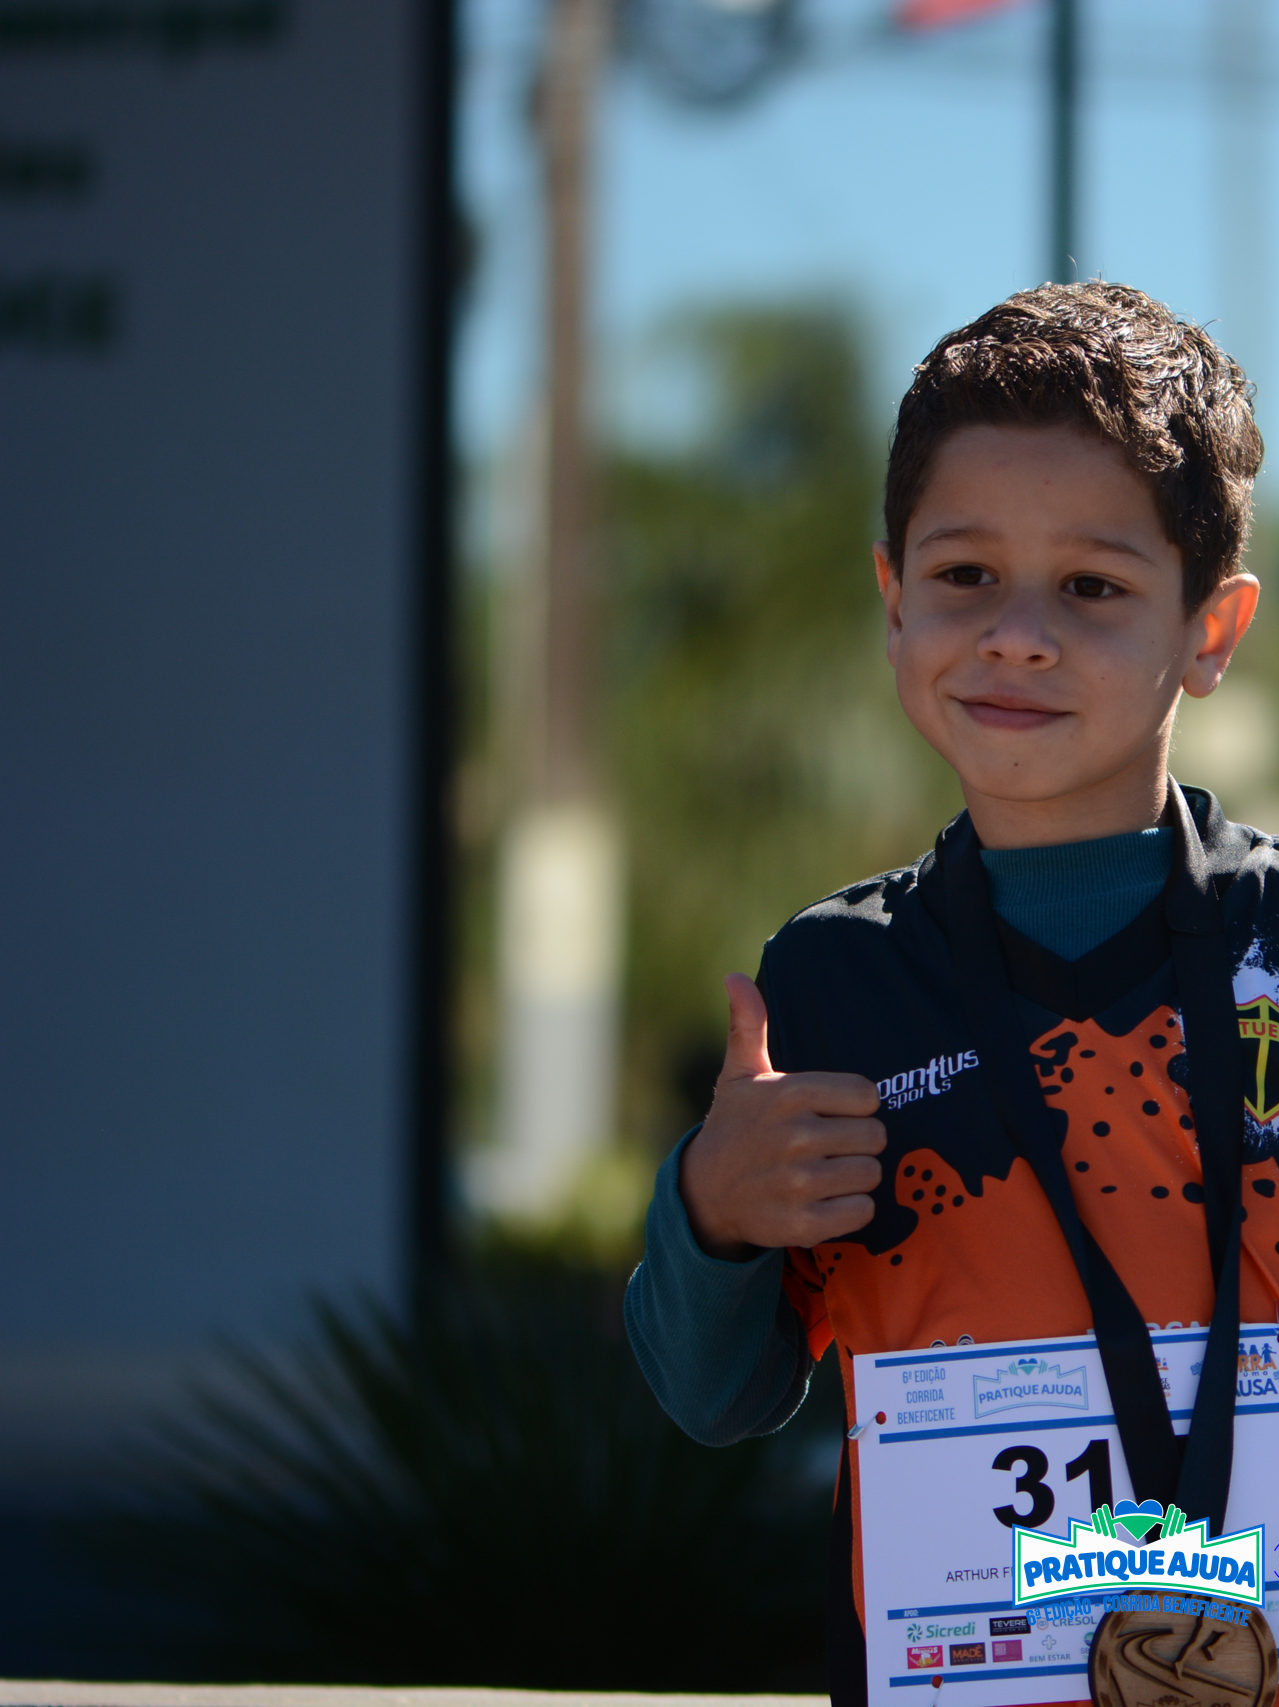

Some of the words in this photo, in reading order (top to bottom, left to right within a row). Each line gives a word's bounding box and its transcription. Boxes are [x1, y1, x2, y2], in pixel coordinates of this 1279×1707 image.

[1237, 1354, 1277, 1373] RRA
[915, 1366, 946, 1384] EDIÇÃO
[978, 1384, 1039, 1404] PRATIQUE
[1041, 1384, 1082, 1396] AJUDA
[1236, 1378, 1278, 1397] USA
[906, 1388, 944, 1404] CORRIDA
[897, 1407, 956, 1425] BENEFICENTE
[946, 1567, 999, 1582] ARTHUR
[1052, 1616, 1098, 1627] CRESOL
[926, 1622, 975, 1638] Sicredi
[952, 1645, 983, 1659] MADÊ
[1029, 1655, 1046, 1663] BEM
[1048, 1653, 1071, 1662] ESTAR
